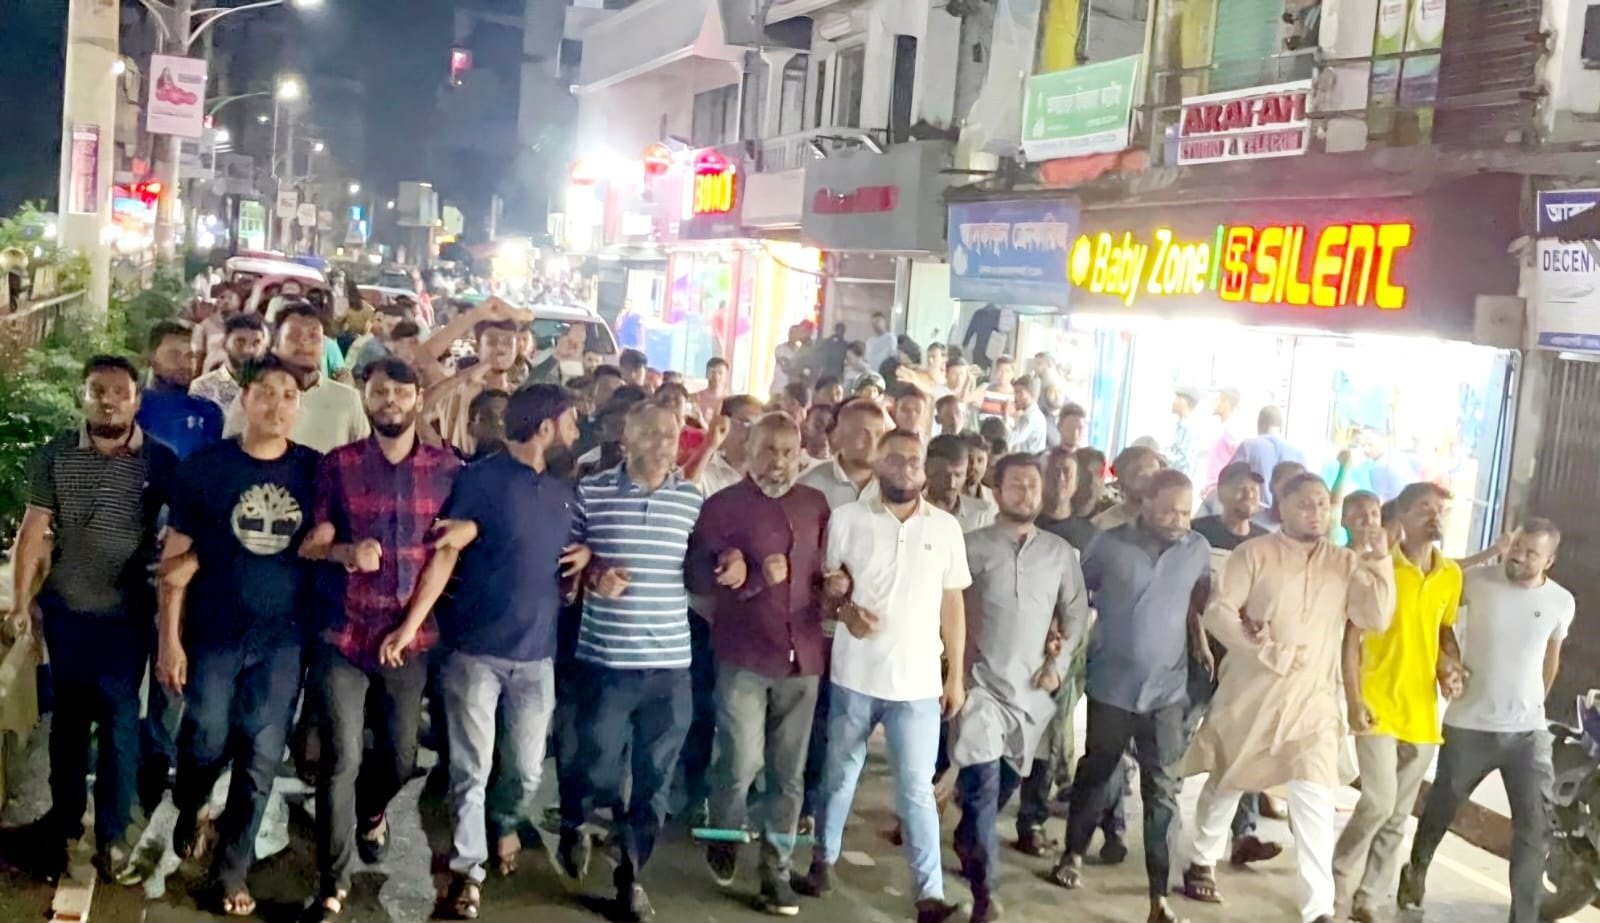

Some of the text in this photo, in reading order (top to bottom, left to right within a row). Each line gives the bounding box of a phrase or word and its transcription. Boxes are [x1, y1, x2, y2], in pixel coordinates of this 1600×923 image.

[1090, 231, 1148, 307] Baby
[1147, 228, 1209, 294] Zone
[1250, 223, 1411, 309] SILENT
